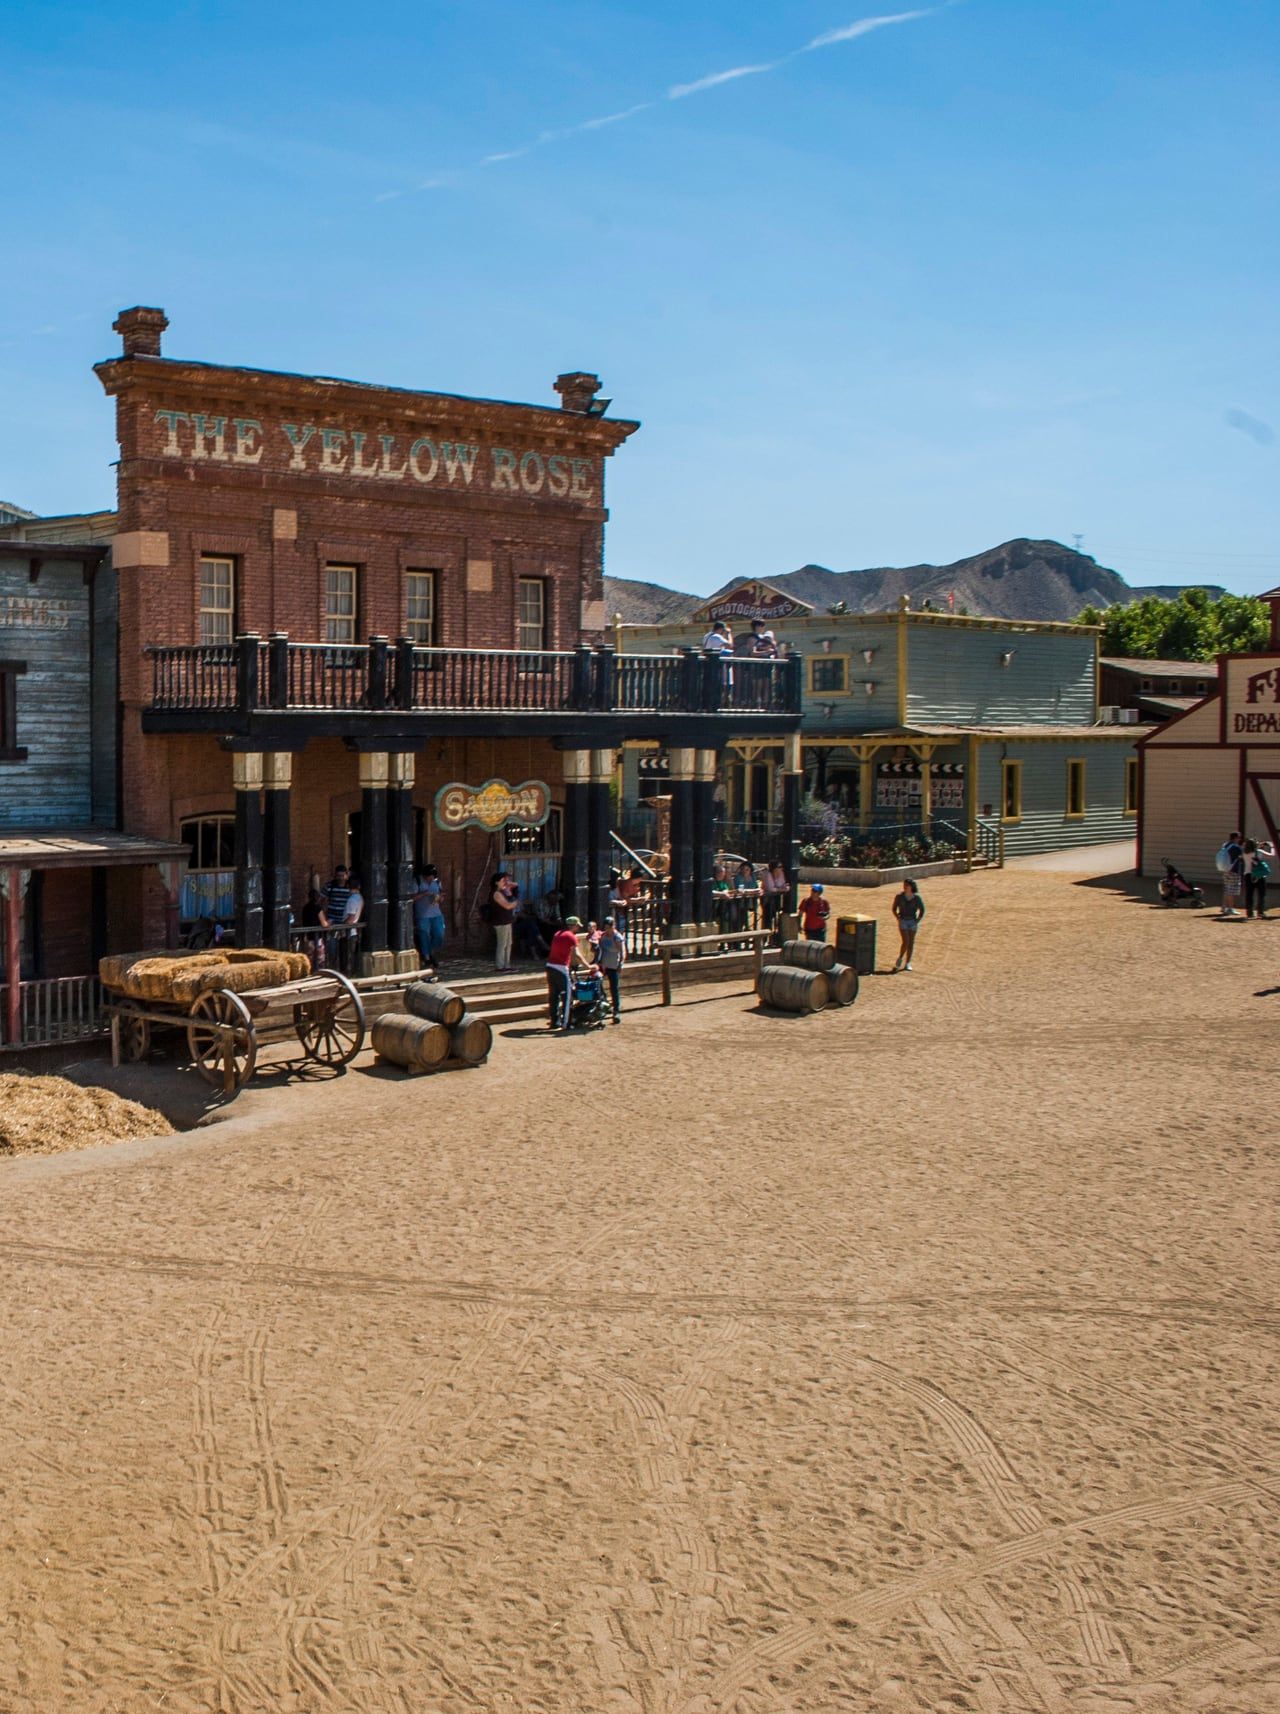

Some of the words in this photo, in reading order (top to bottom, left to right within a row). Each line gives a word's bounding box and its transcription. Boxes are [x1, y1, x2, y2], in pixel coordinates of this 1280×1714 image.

[154, 409, 264, 464] THE
[281, 423, 479, 486] YELLOW
[490, 446, 595, 500] ROSE
[710, 601, 792, 620] PHOTOGRAPHERS
[1234, 713, 1280, 733] DEPA
[446, 790, 538, 821] SALOON
